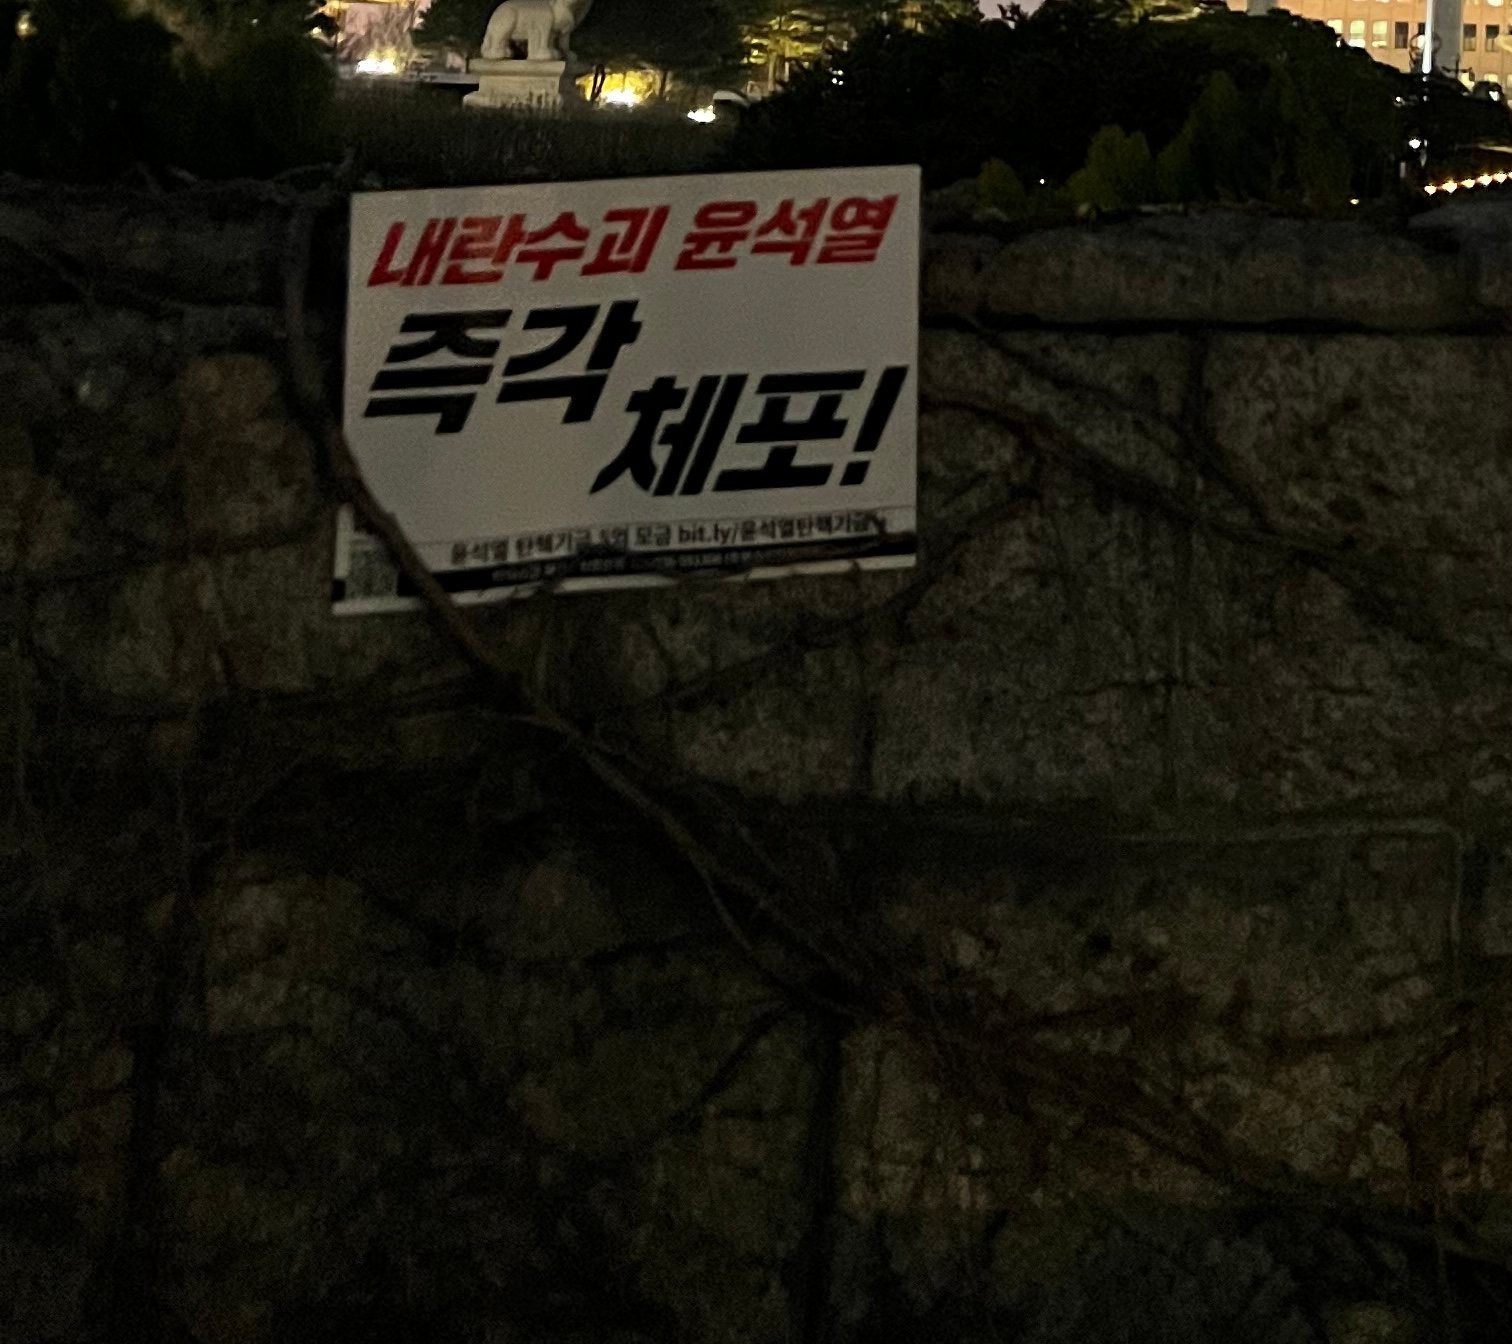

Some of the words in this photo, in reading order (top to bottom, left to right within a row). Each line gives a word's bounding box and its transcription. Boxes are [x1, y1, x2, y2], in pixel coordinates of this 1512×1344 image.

[367, 204, 671, 287] 내란수괴
[674, 195, 899, 272] 윤석열
[363, 300, 643, 435] 즉각
[589, 365, 910, 498] 체포!
